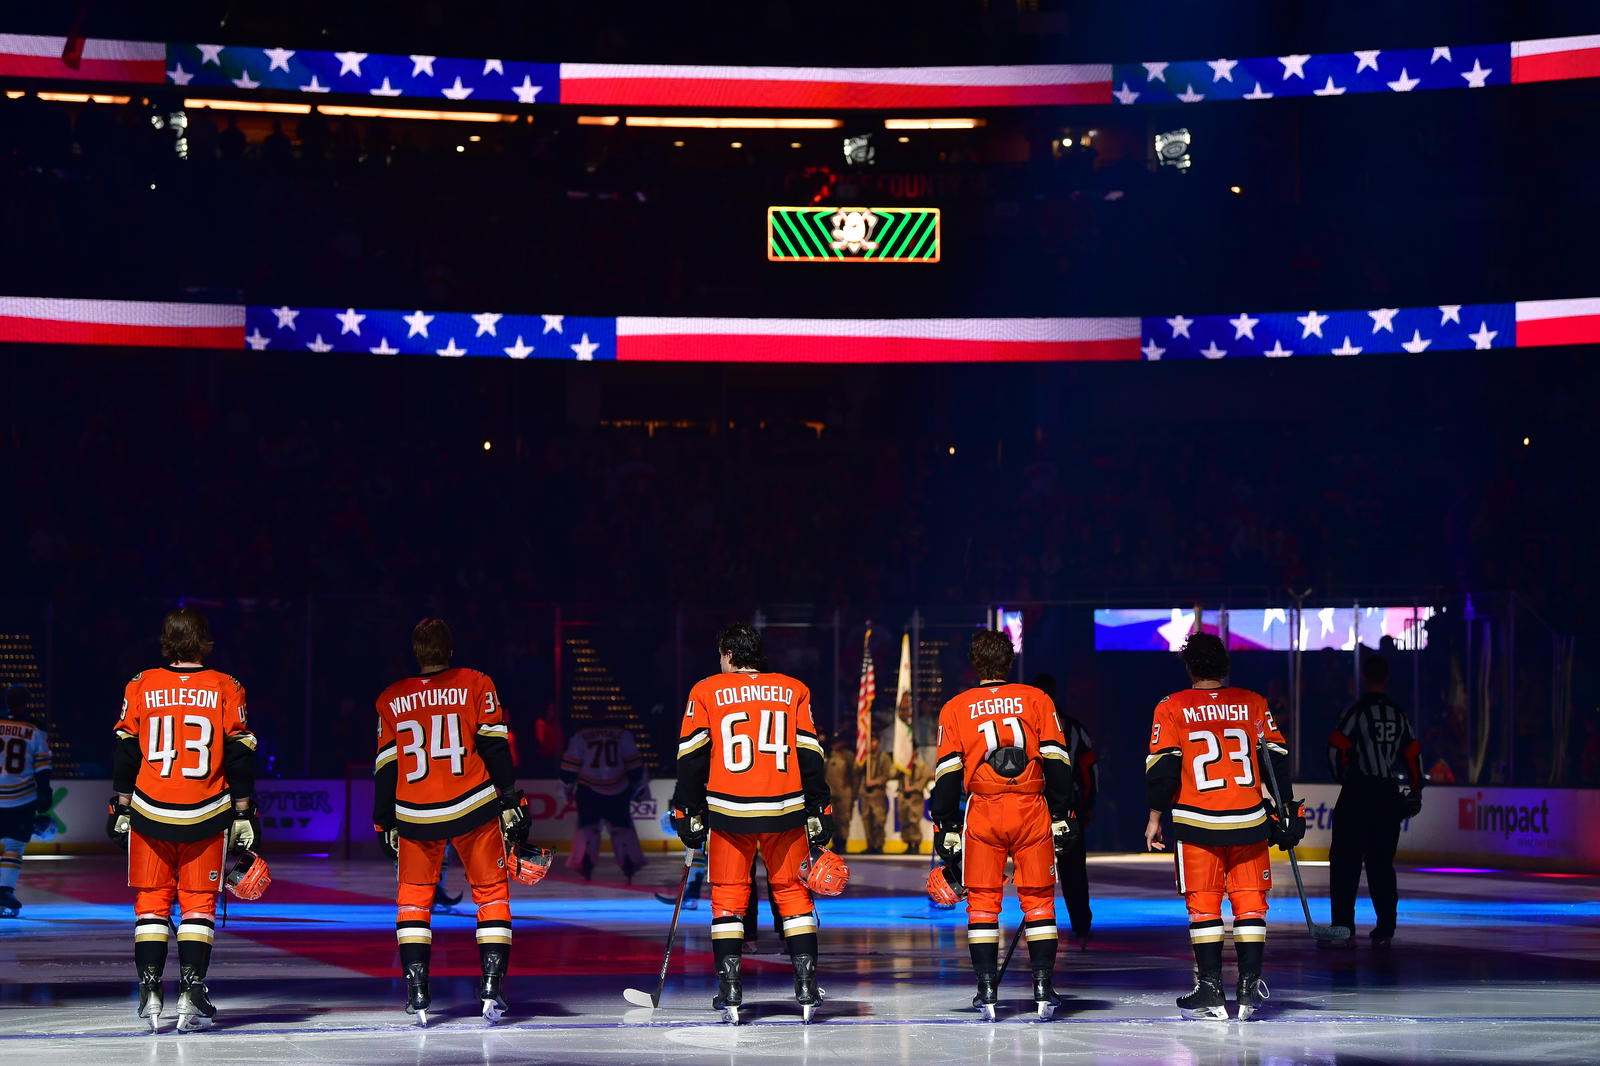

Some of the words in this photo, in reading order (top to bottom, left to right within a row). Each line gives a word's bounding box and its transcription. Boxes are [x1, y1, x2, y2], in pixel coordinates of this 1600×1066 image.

[144, 688, 219, 709] HELLESON
[714, 685, 793, 707] COLANGELO
[967, 697, 1023, 720] ZEGRAS
[1182, 704, 1249, 724] McTAVISH
[147, 714, 214, 780] 43
[396, 713, 467, 784] 34
[720, 709, 792, 775] 64
[977, 716, 1028, 762] 11
[1374, 721, 1397, 743] 32
[587, 739, 619, 769] 70
[1188, 728, 1256, 793] 23
[1477, 791, 1550, 840] impact
